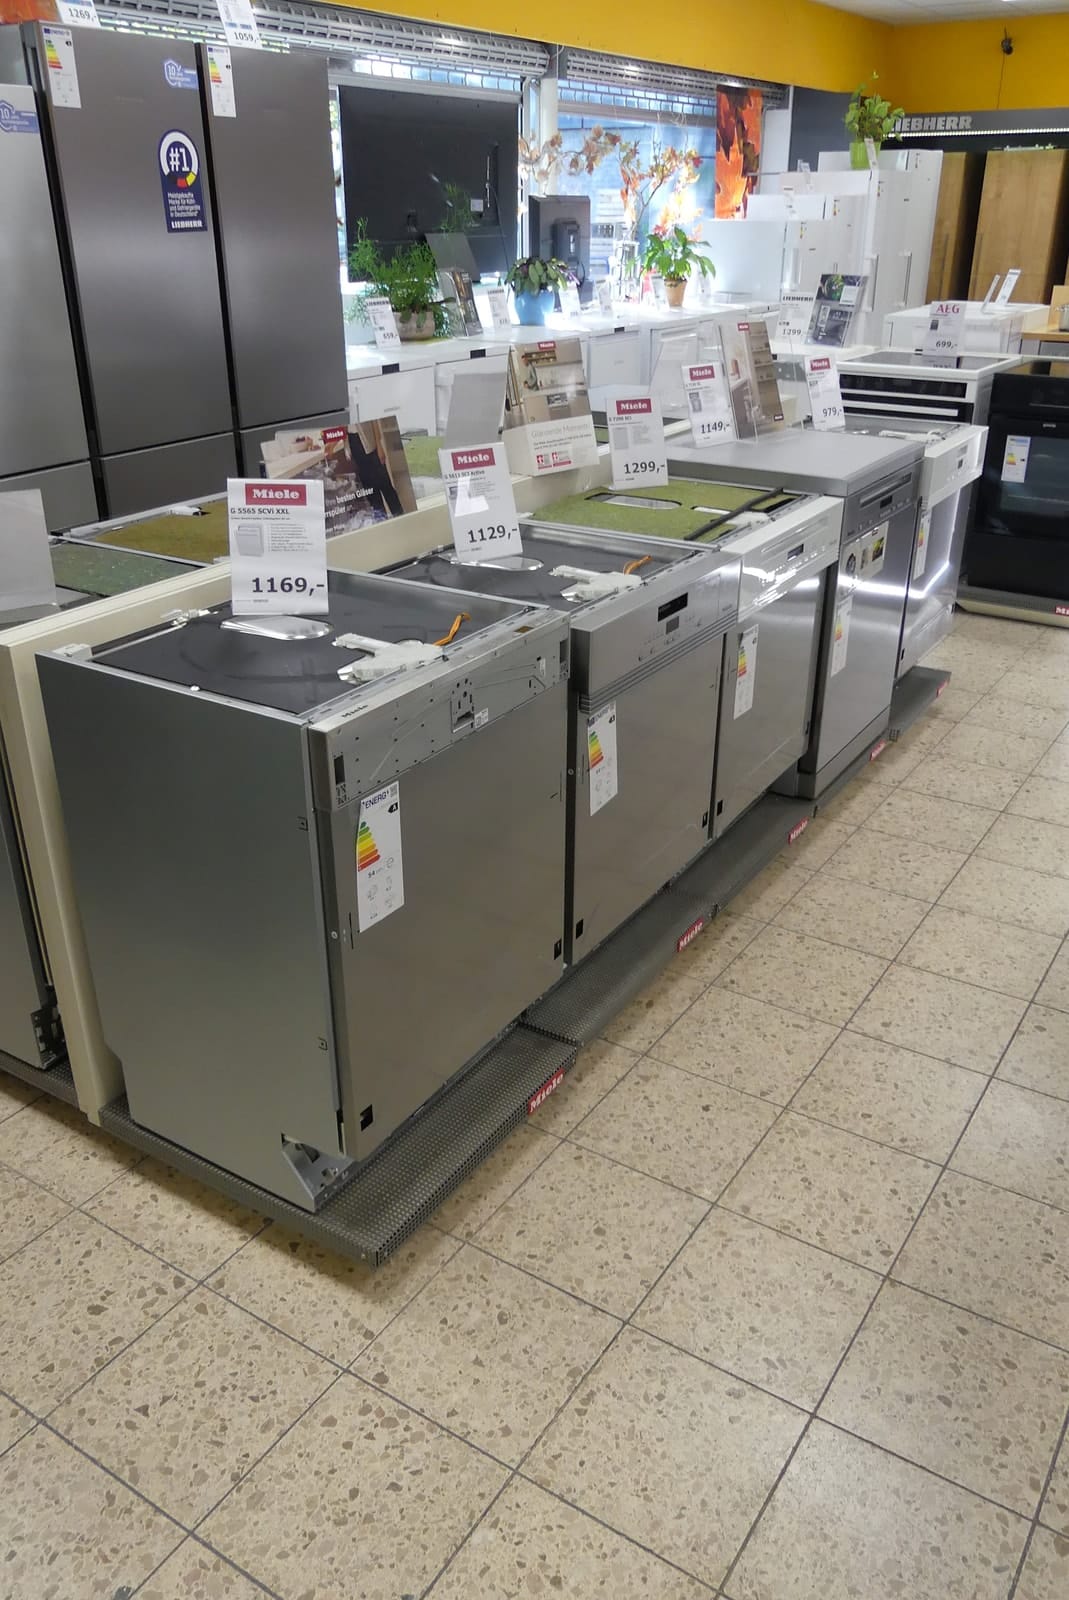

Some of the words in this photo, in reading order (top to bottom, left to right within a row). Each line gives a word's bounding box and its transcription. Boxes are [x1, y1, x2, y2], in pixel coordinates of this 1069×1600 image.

[891, 116, 972, 131] IEBHERR
[169, 147, 189, 171] #1
[936, 304, 959, 313] AEG
[935, 340, 958, 349] 699,-
[692, 369, 711, 377] Miele
[620, 402, 647, 410] Miele
[822, 406, 842, 416] 979,-
[700, 420, 729, 433] 1149,-
[326, 430, 343, 439] Miele
[456, 453, 490, 464] Miele
[624, 460, 664, 474] 1299,-
[252, 488, 299, 498] Miele
[467, 524, 517, 543] 1129,-
[251, 576, 325, 596] 1169,-
[679, 921, 703, 951] Miele
[529, 1073, 564, 1113] Miele
